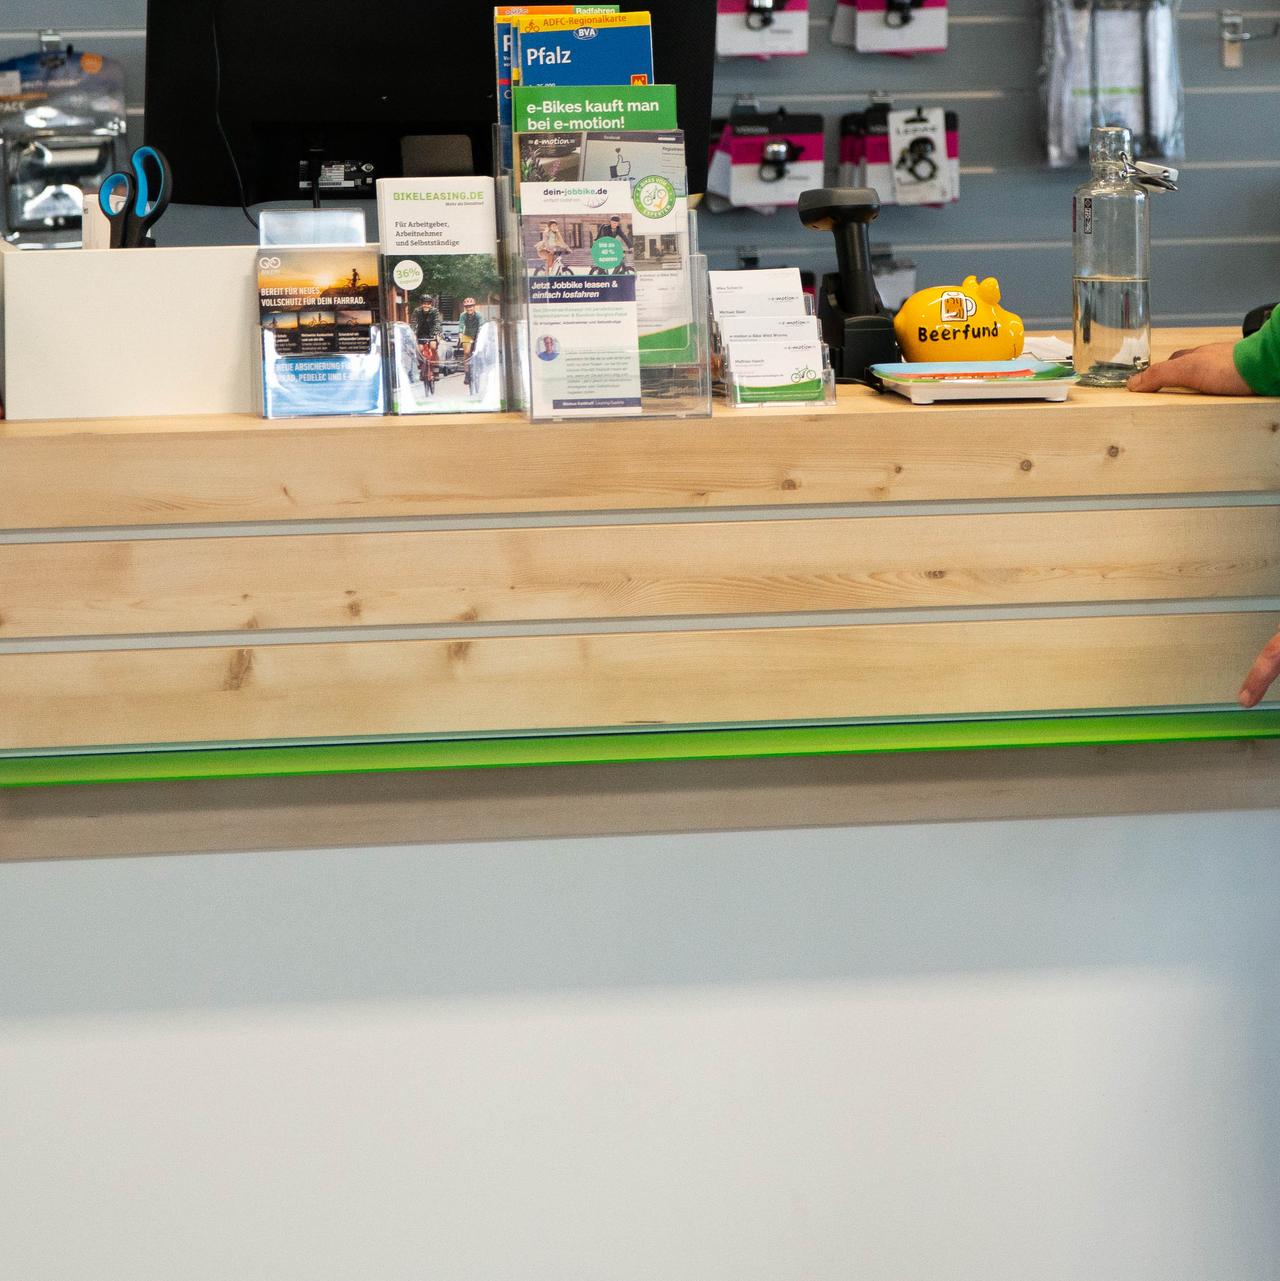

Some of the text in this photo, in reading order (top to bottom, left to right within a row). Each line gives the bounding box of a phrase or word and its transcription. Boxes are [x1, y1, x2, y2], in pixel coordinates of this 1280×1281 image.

[575, 6, 615, 14] Radfahren
[543, 15, 627, 27] ADFC-Regionalkarte
[578, 28, 596, 38] BVA
[527, 46, 572, 65] Pfalz
[527, 99, 659, 114] e-Bikes kauft man
[527, 116, 625, 130] bei e-motion!
[533, 136, 571, 145] e-motion
[393, 192, 484, 201] BIKELEASING.DE
[543, 187, 608, 197] dein-jobbike.de
[408, 221, 450, 229] Arbeitgeber,
[396, 268, 420, 279] 36%
[531, 282, 550, 290] Jetzt
[551, 281, 583, 289] Jobbike
[261, 286, 320, 296] BEREIT FÜR NEUES.
[532, 291, 561, 299] einfach
[261, 296, 366, 307] VOLLSCHUTZ FÜR DEIN FAHRRAD.
[918, 322, 999, 342] Beerfund
